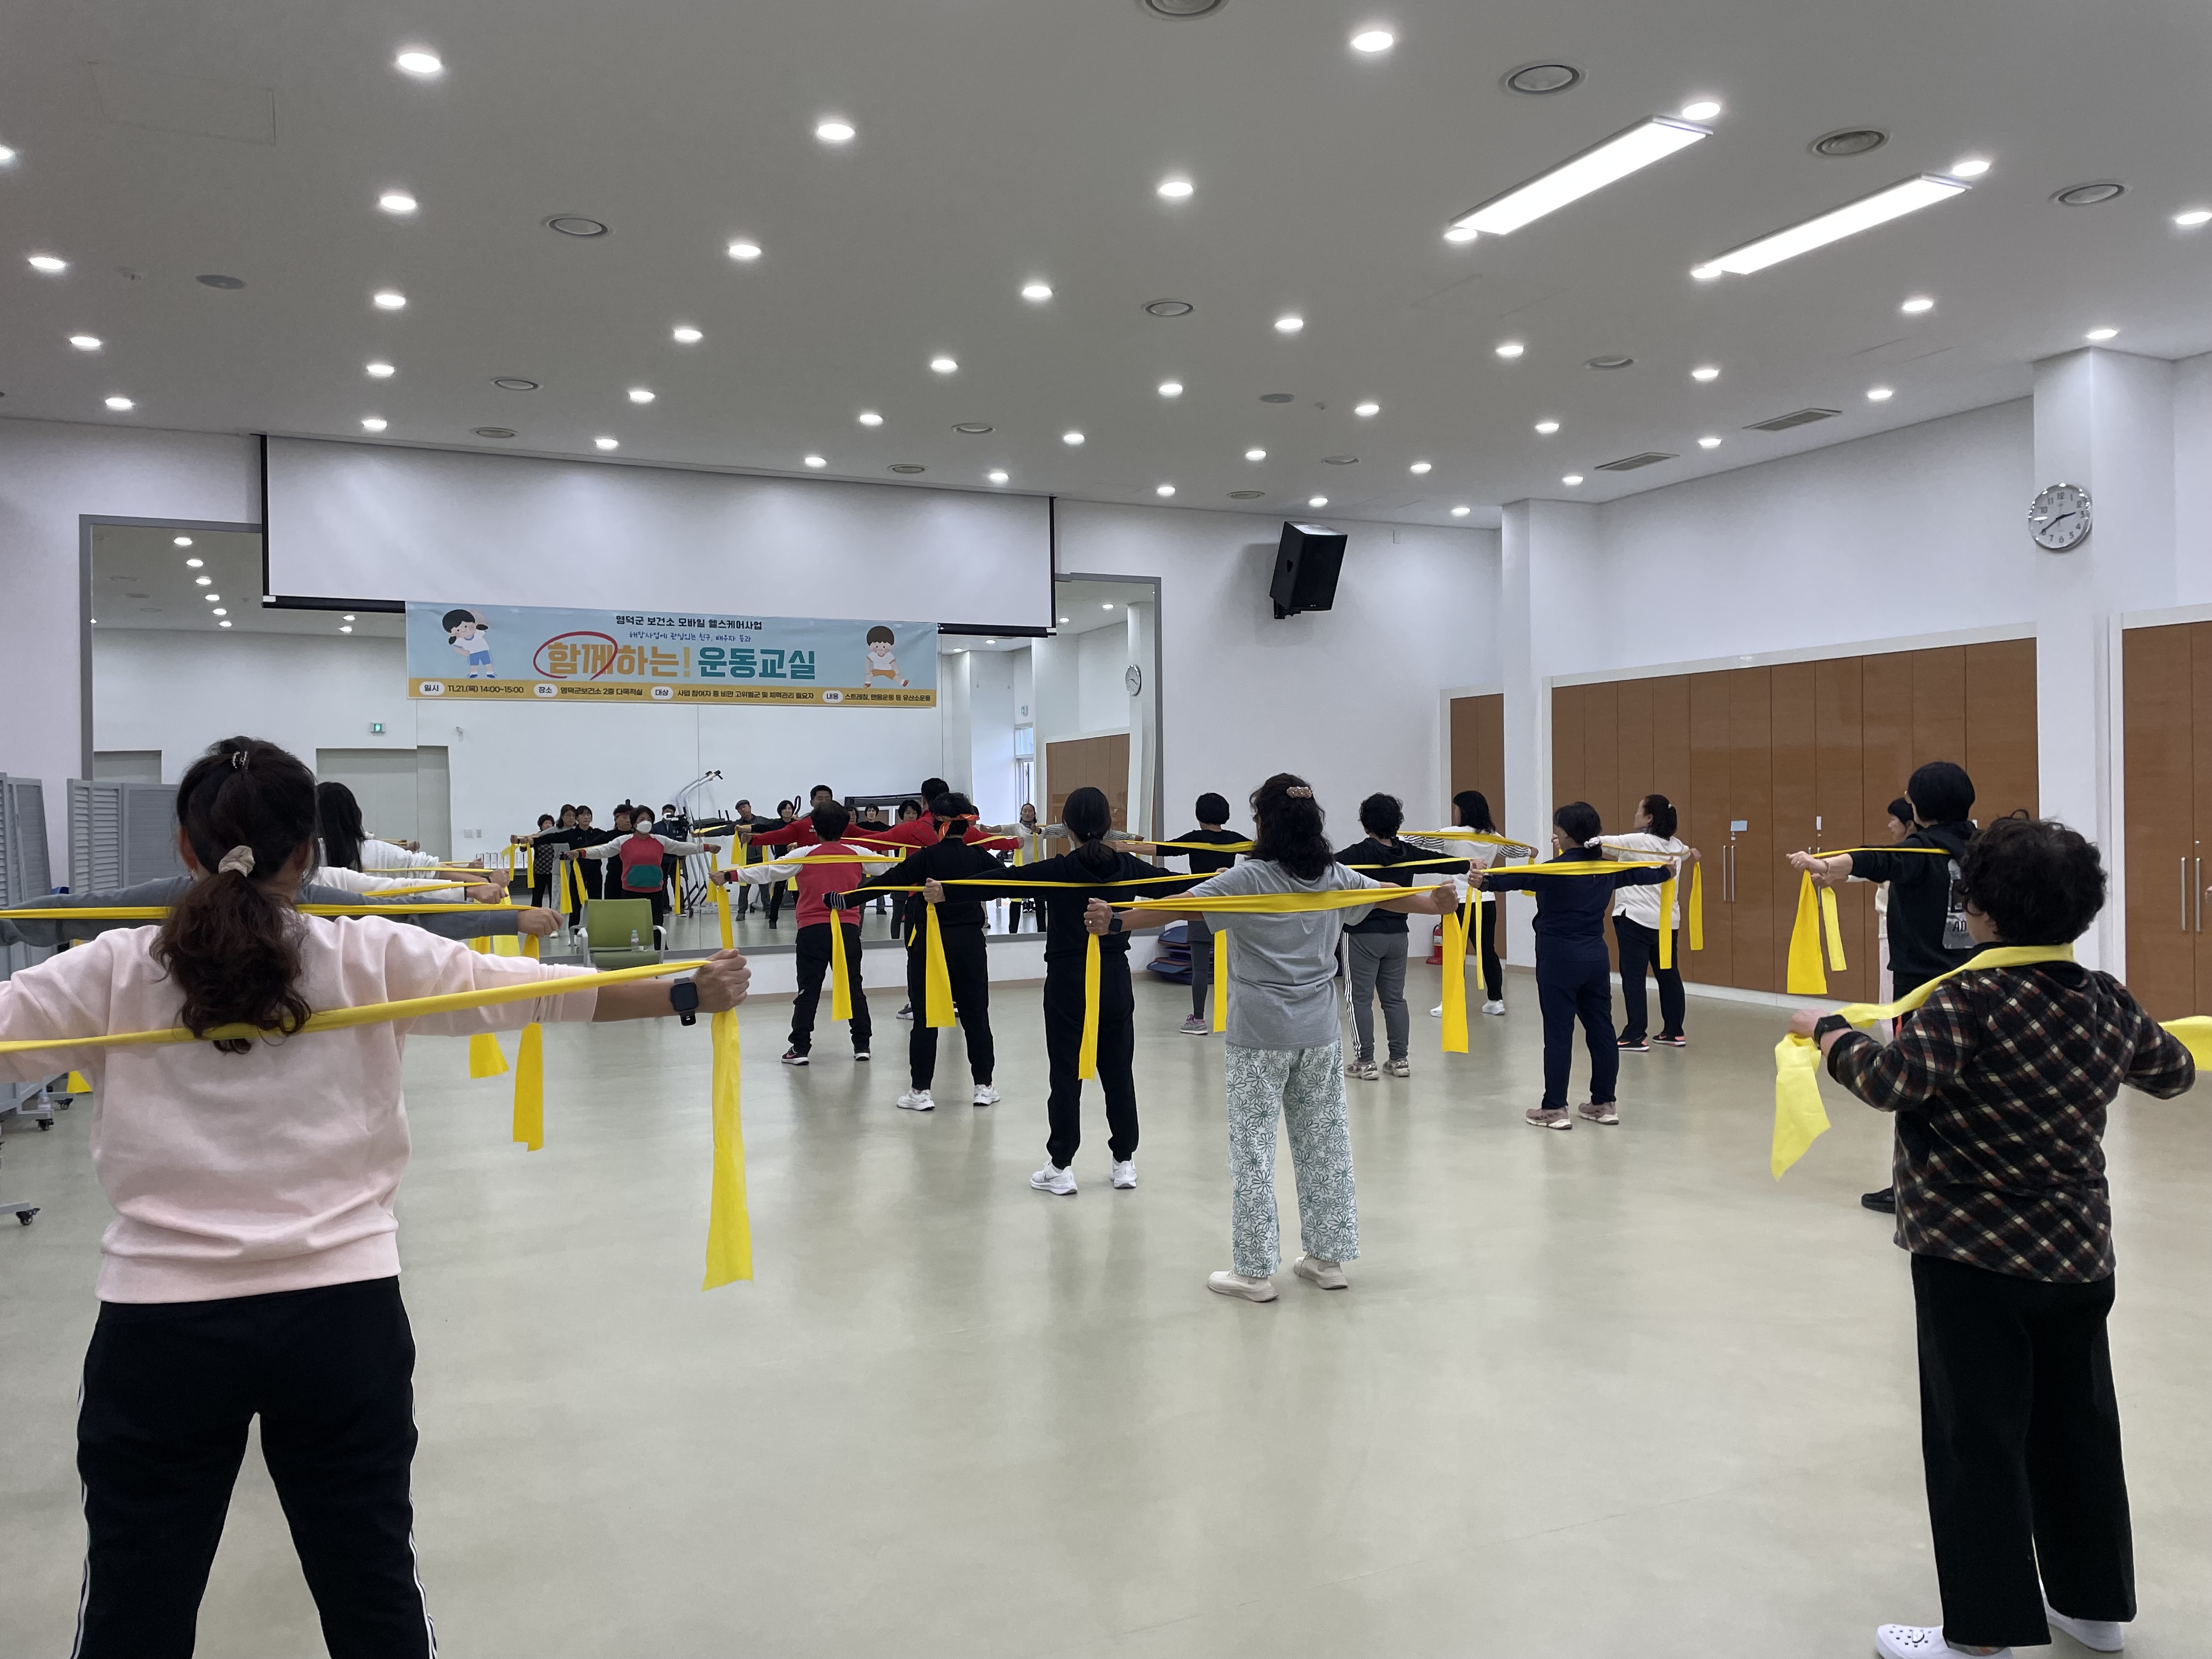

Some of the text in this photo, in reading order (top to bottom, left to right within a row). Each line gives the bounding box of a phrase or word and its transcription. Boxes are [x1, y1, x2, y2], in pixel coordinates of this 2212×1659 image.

[616, 615, 763, 630] 영덕군 보건소 모바일 헬스케어사업
[629, 631, 668, 639] 해당사업에
[670, 632, 696, 641] 관심있는
[699, 633, 713, 642] 친구,
[548, 642, 816, 680] 함께하는! 운동교실
